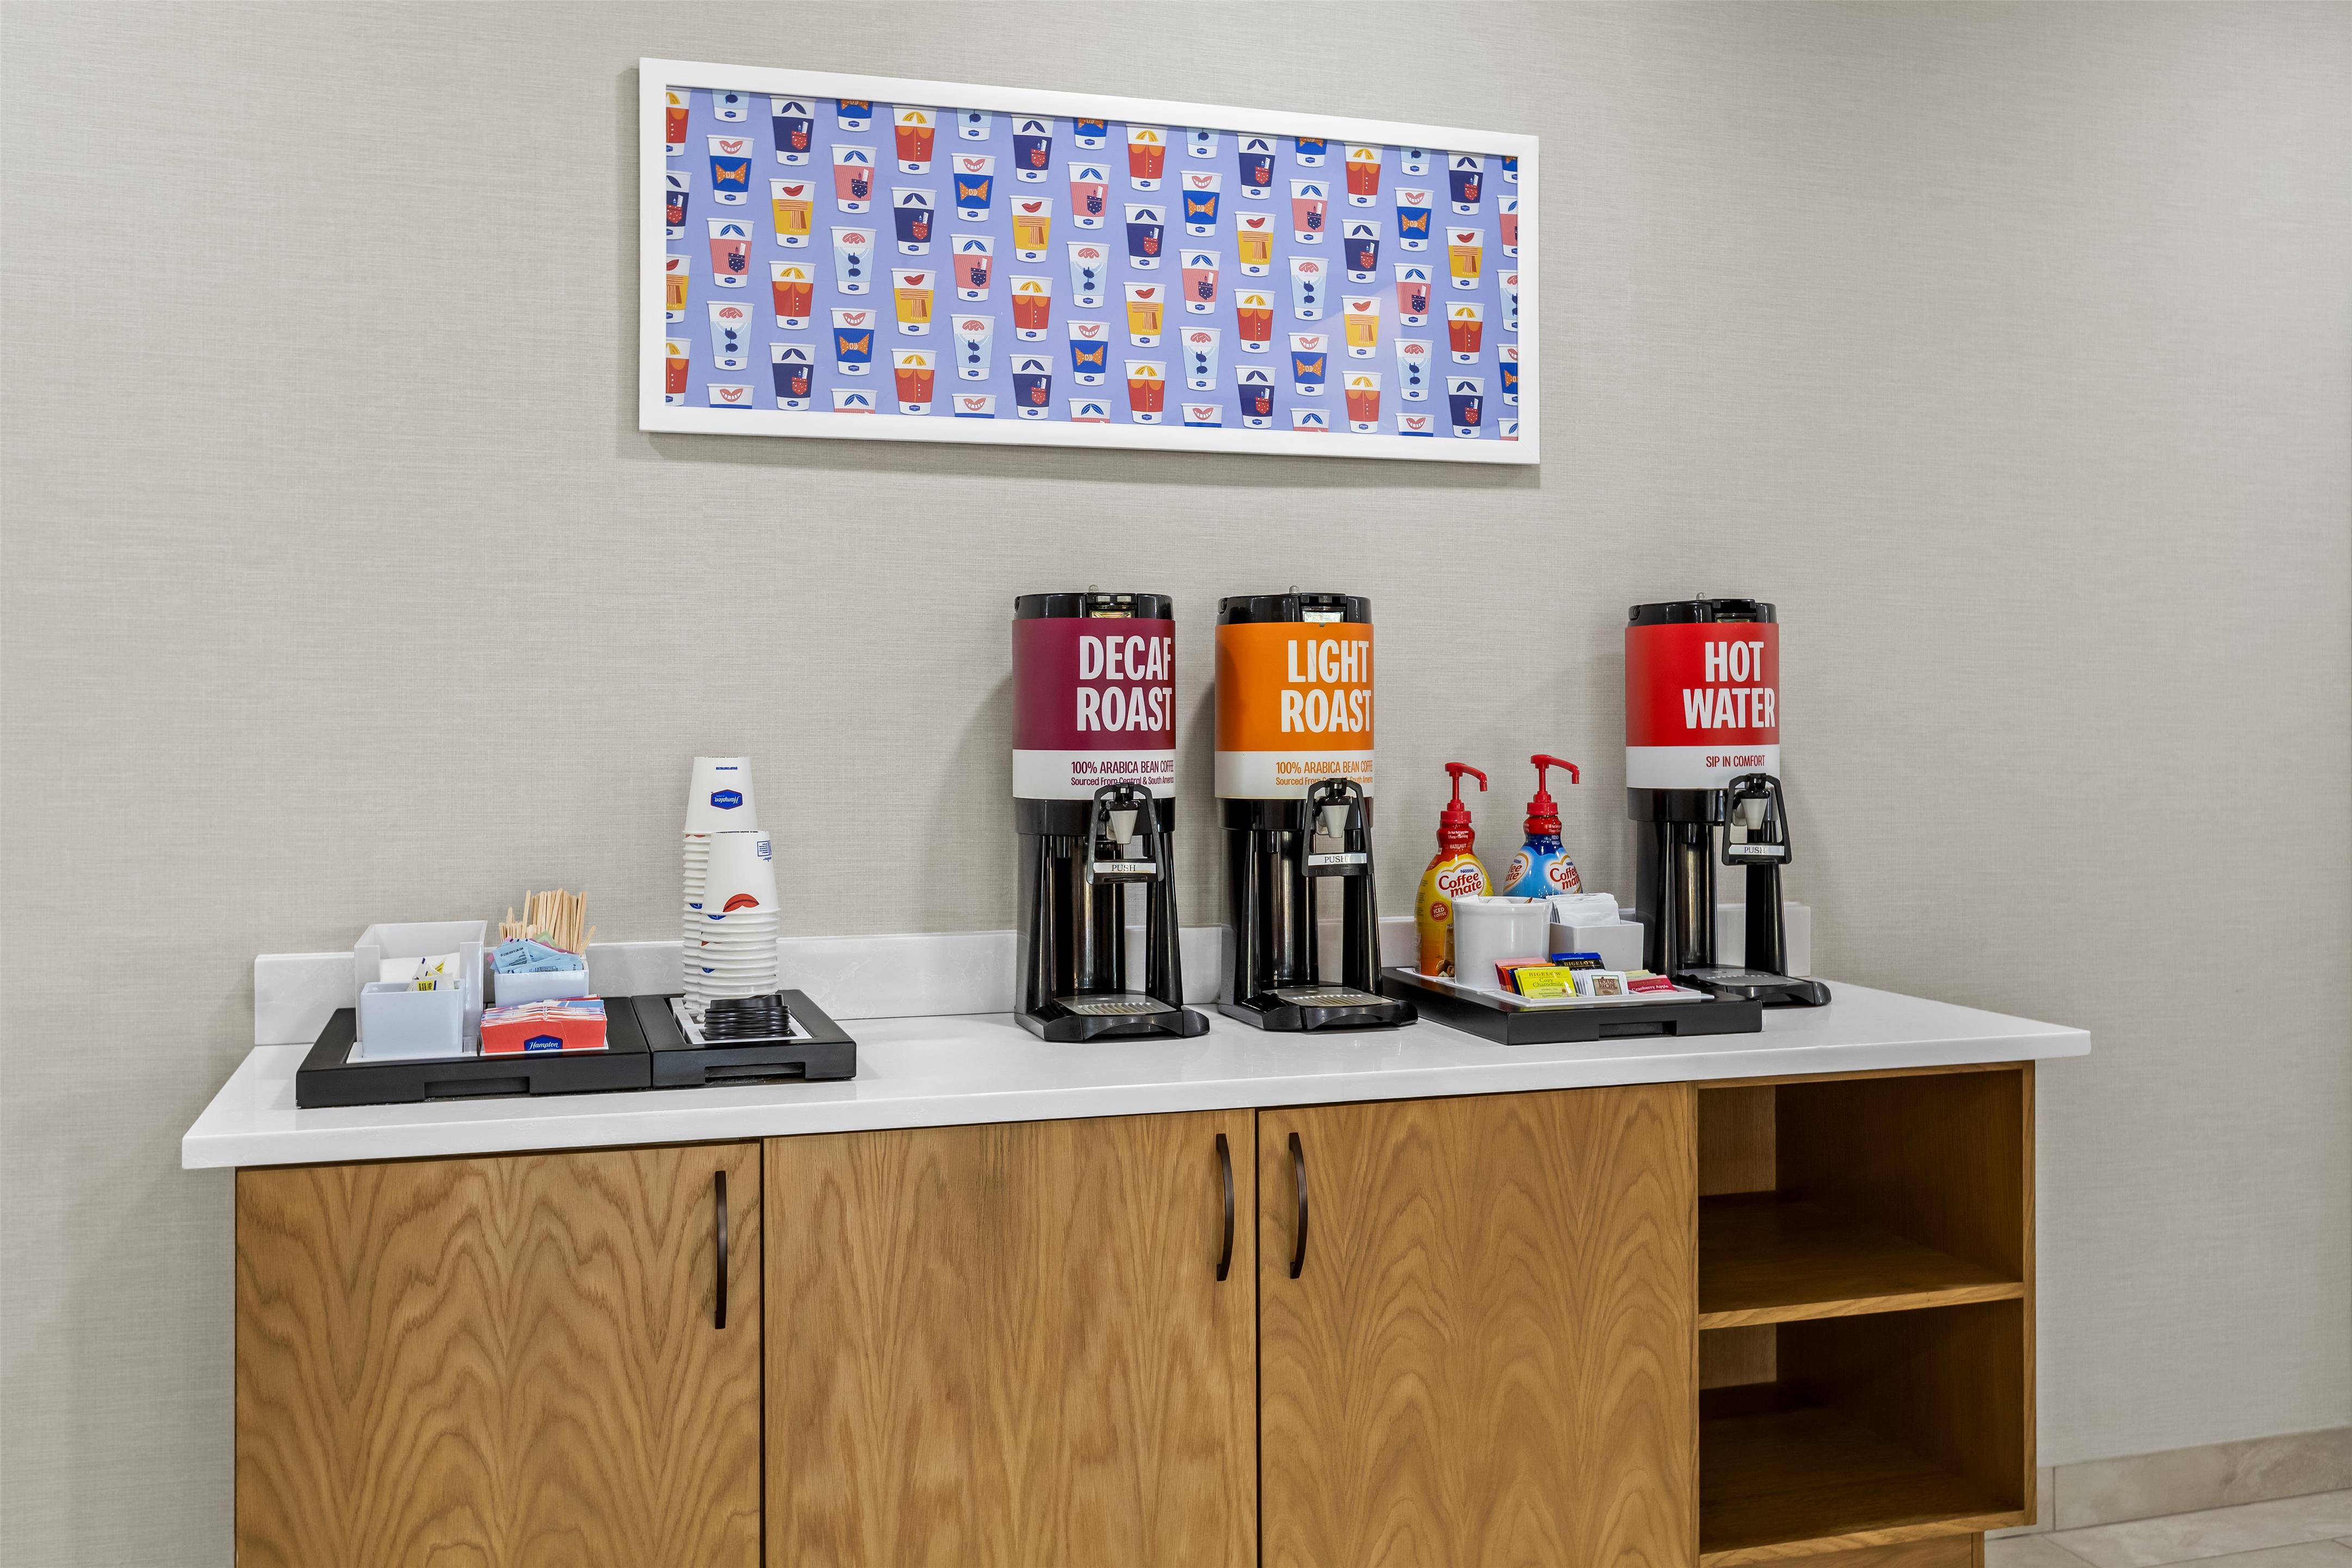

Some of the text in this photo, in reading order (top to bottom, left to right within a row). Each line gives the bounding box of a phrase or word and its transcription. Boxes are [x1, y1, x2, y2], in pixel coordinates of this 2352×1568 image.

[1079, 635, 1171, 681] DECAF
[1288, 639, 1369, 683] LIGHT
[1705, 640, 1764, 682] HOT
[1076, 686, 1172, 732] ROAST
[1281, 689, 1371, 733] ROAST
[1682, 687, 1775, 729] WATER
[1071, 759, 1174, 774] 100% ARABICA BEAN COFFEE
[1276, 759, 1373, 774] 100% ARABICA BEAN COFFEE
[1706, 755, 1765, 768] SIP IN COMFORT
[1071, 777, 1099, 786] Sourced
[1143, 776, 1147, 785] &
[1148, 776, 1162, 785] South
[1276, 777, 1303, 785] Sourced
[714, 795, 740, 804] Hampton
[1438, 873, 1479, 890] Coffee
[1450, 880, 1482, 898] mate
[527, 1041, 560, 1051] Hampton
